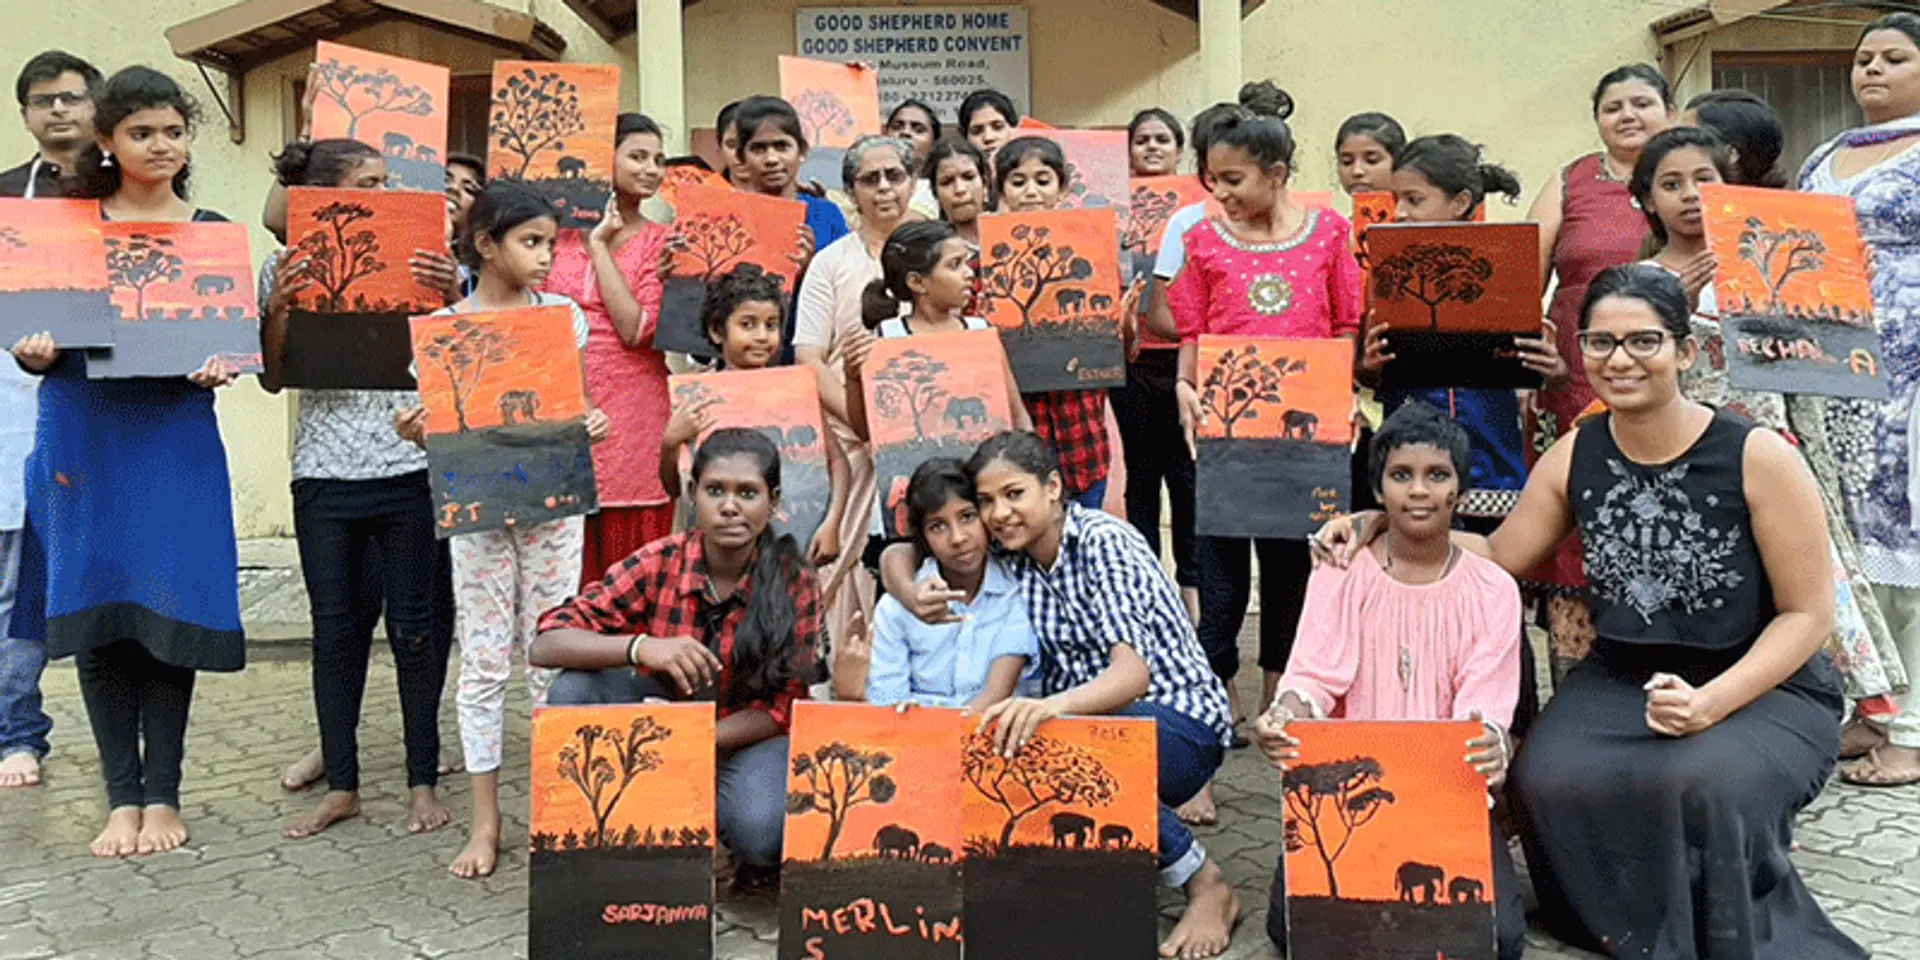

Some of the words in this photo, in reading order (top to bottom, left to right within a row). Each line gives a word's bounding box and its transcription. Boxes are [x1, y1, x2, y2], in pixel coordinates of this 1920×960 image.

[815, 14, 863, 31] GOOD
[868, 13, 957, 31] SHEPHERD
[962, 12, 1010, 30] HOME
[803, 38, 848, 54] GOOD
[853, 37, 939, 54] SHEPHERD
[944, 35, 1022, 52] CONVENT
[879, 59, 942, 71] Museum
[877, 74, 918, 86] aluru
